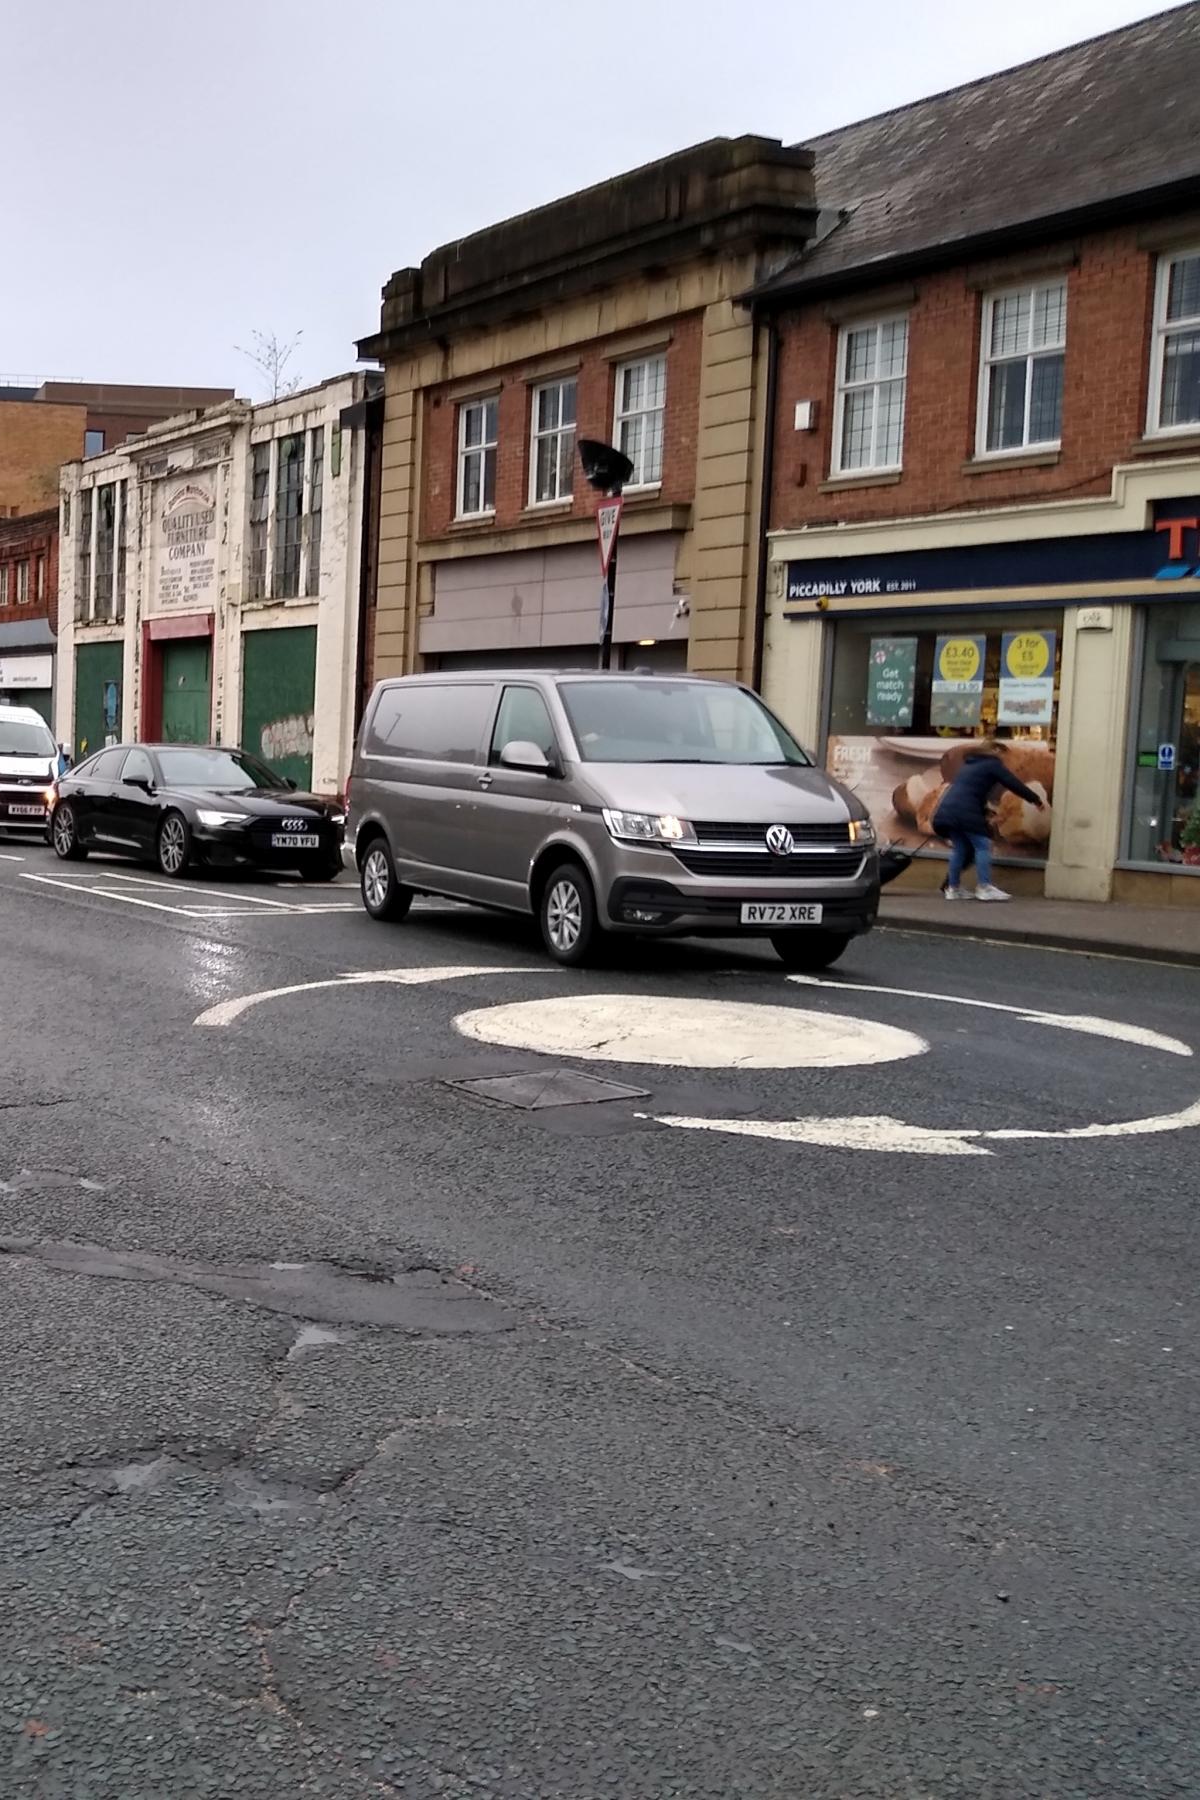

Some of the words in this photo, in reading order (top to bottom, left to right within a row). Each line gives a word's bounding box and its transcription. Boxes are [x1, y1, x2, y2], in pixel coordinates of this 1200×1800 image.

[162, 513, 194, 533] QUALITY
[195, 509, 215, 526] USED
[601, 508, 616, 527] GIVE
[167, 525, 209, 545] FURNITURE
[1155, 517, 1200, 560] T
[168, 543, 206, 561] COMPANY
[789, 581, 848, 597] PICCADILLY
[850, 579, 881, 594] YORK
[1017, 638, 1023, 648] 3
[1026, 638, 1040, 648] for
[946, 647, 975, 658] £3.40
[1022, 651, 1034, 661] £5
[882, 667, 899, 679] Get
[876, 680, 904, 690] match
[877, 691, 903, 703] ready
[833, 745, 872, 763] FRESH
[300, 836, 317, 847] VFU
[747, 906, 786, 921] RV72
[788, 906, 816, 921] XRE
